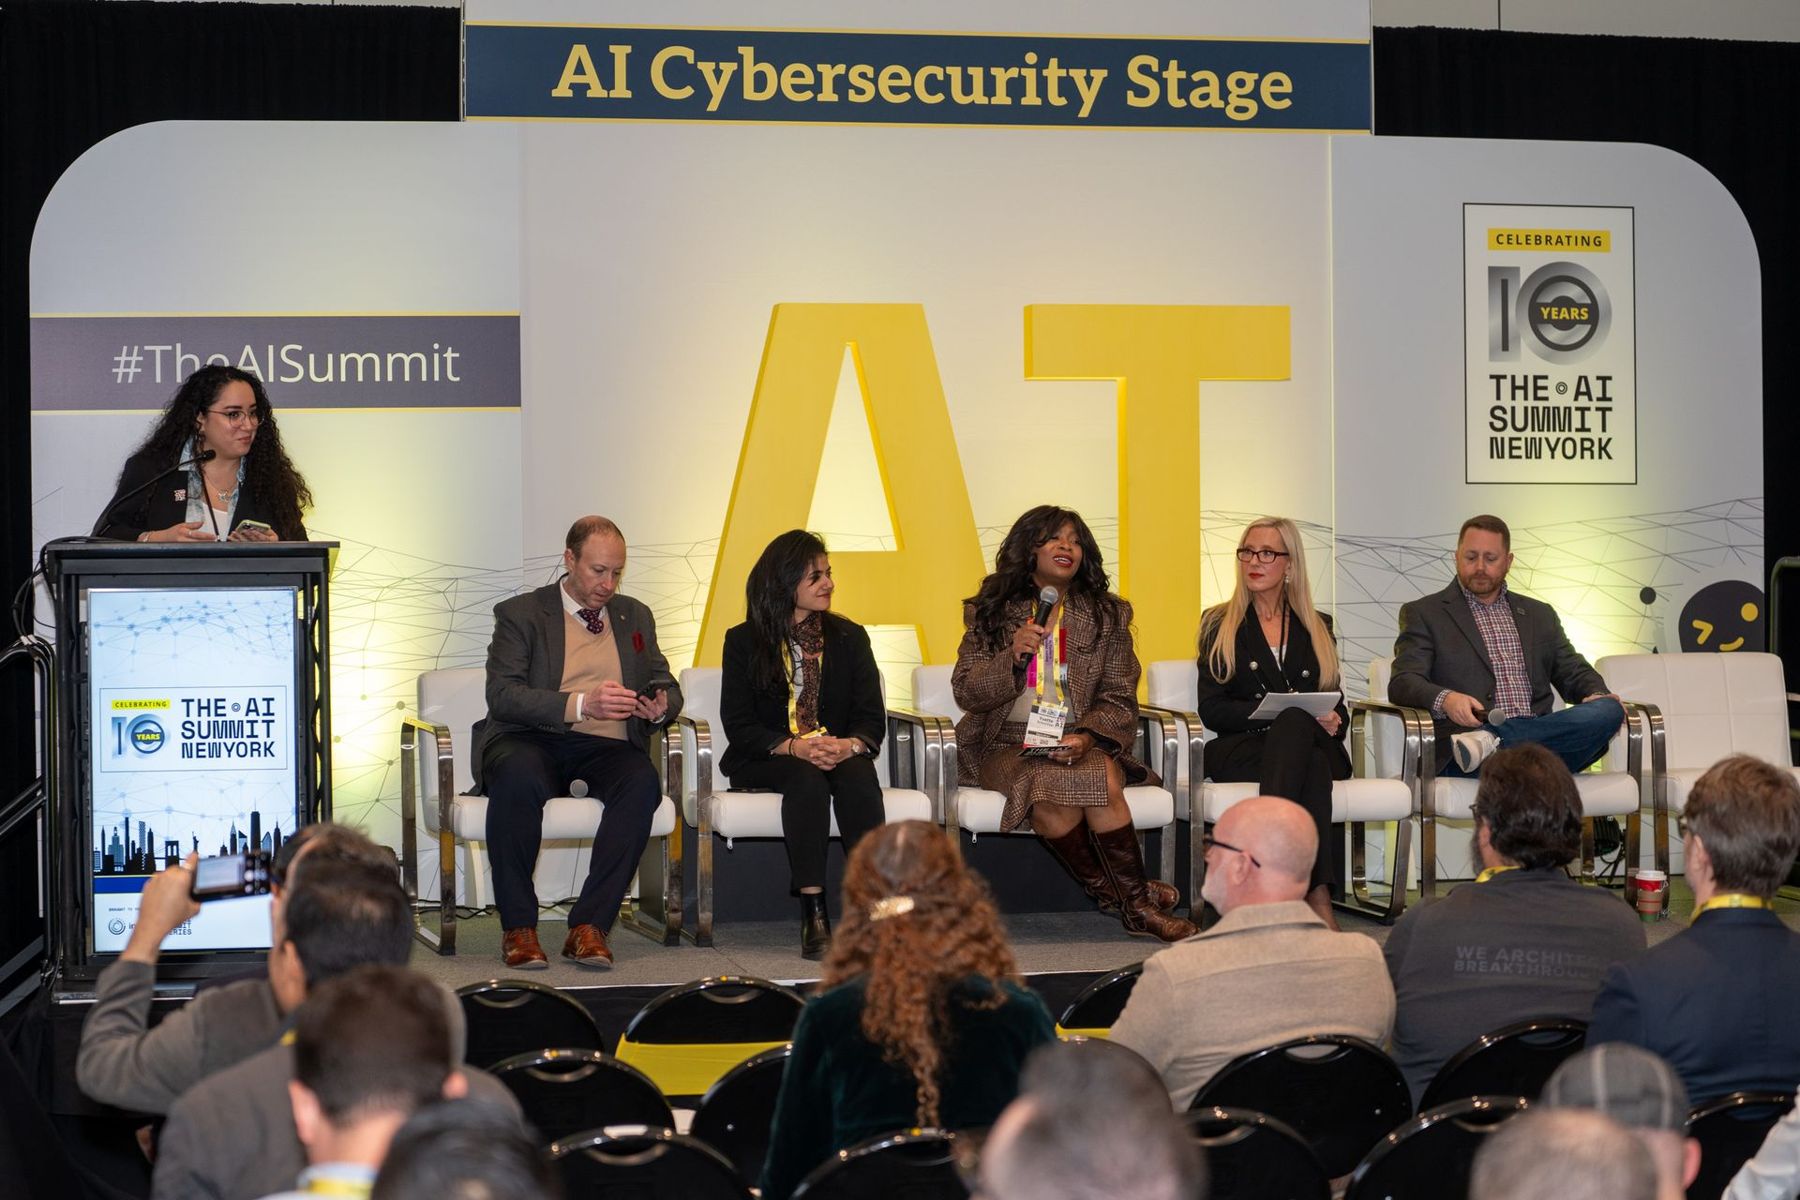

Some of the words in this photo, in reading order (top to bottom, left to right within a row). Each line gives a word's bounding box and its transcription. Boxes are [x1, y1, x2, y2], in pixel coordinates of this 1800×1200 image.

[551, 44, 632, 98] AI
[650, 45, 1108, 117] Cybersecurity
[1126, 54, 1294, 121] Stage
[1496, 233, 1603, 247] CELEBRATING
[1540, 306, 1590, 320] YEARS
[1489, 374, 1550, 401] THE
[1573, 375, 1613, 402] AI
[1488, 405, 1613, 433] SUMMIT
[180, 698, 227, 718] THE
[245, 697, 276, 717] AI
[135, 733, 161, 741] YEARS
[180, 719, 276, 740] SUMMIT
[1456, 946, 1488, 961] WE
